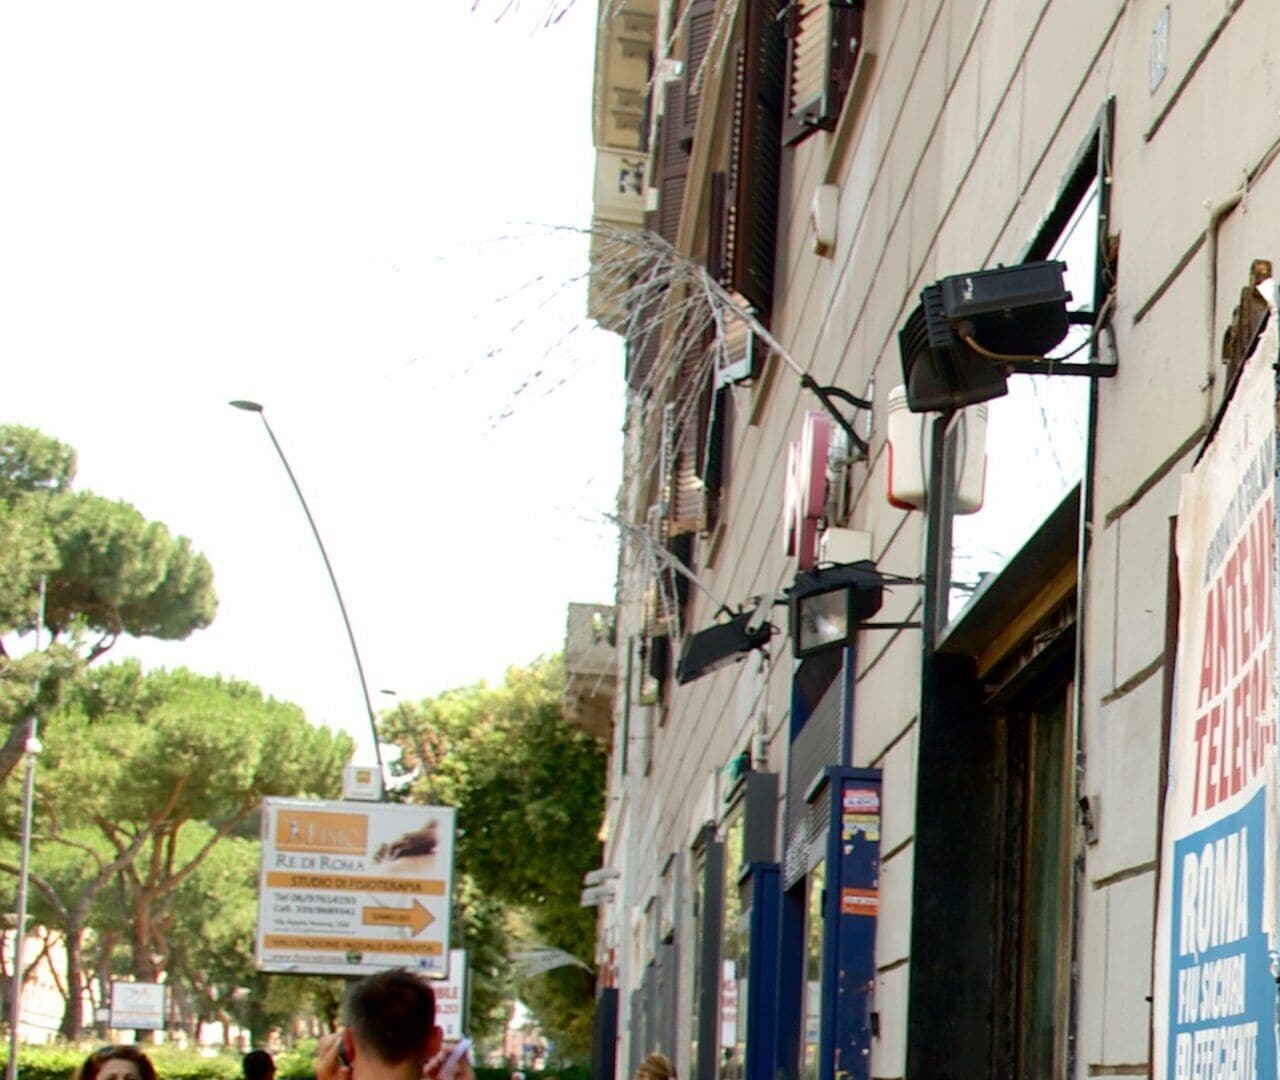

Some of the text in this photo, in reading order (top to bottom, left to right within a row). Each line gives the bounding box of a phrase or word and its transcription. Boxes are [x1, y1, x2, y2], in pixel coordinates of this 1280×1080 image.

[290, 876, 423, 893] STUDIO DI FISIOTERAPIA
[319, 856, 366, 872] ROMA
[1179, 826, 1249, 957] ROMA
[1201, 952, 1247, 1022] SICURA
